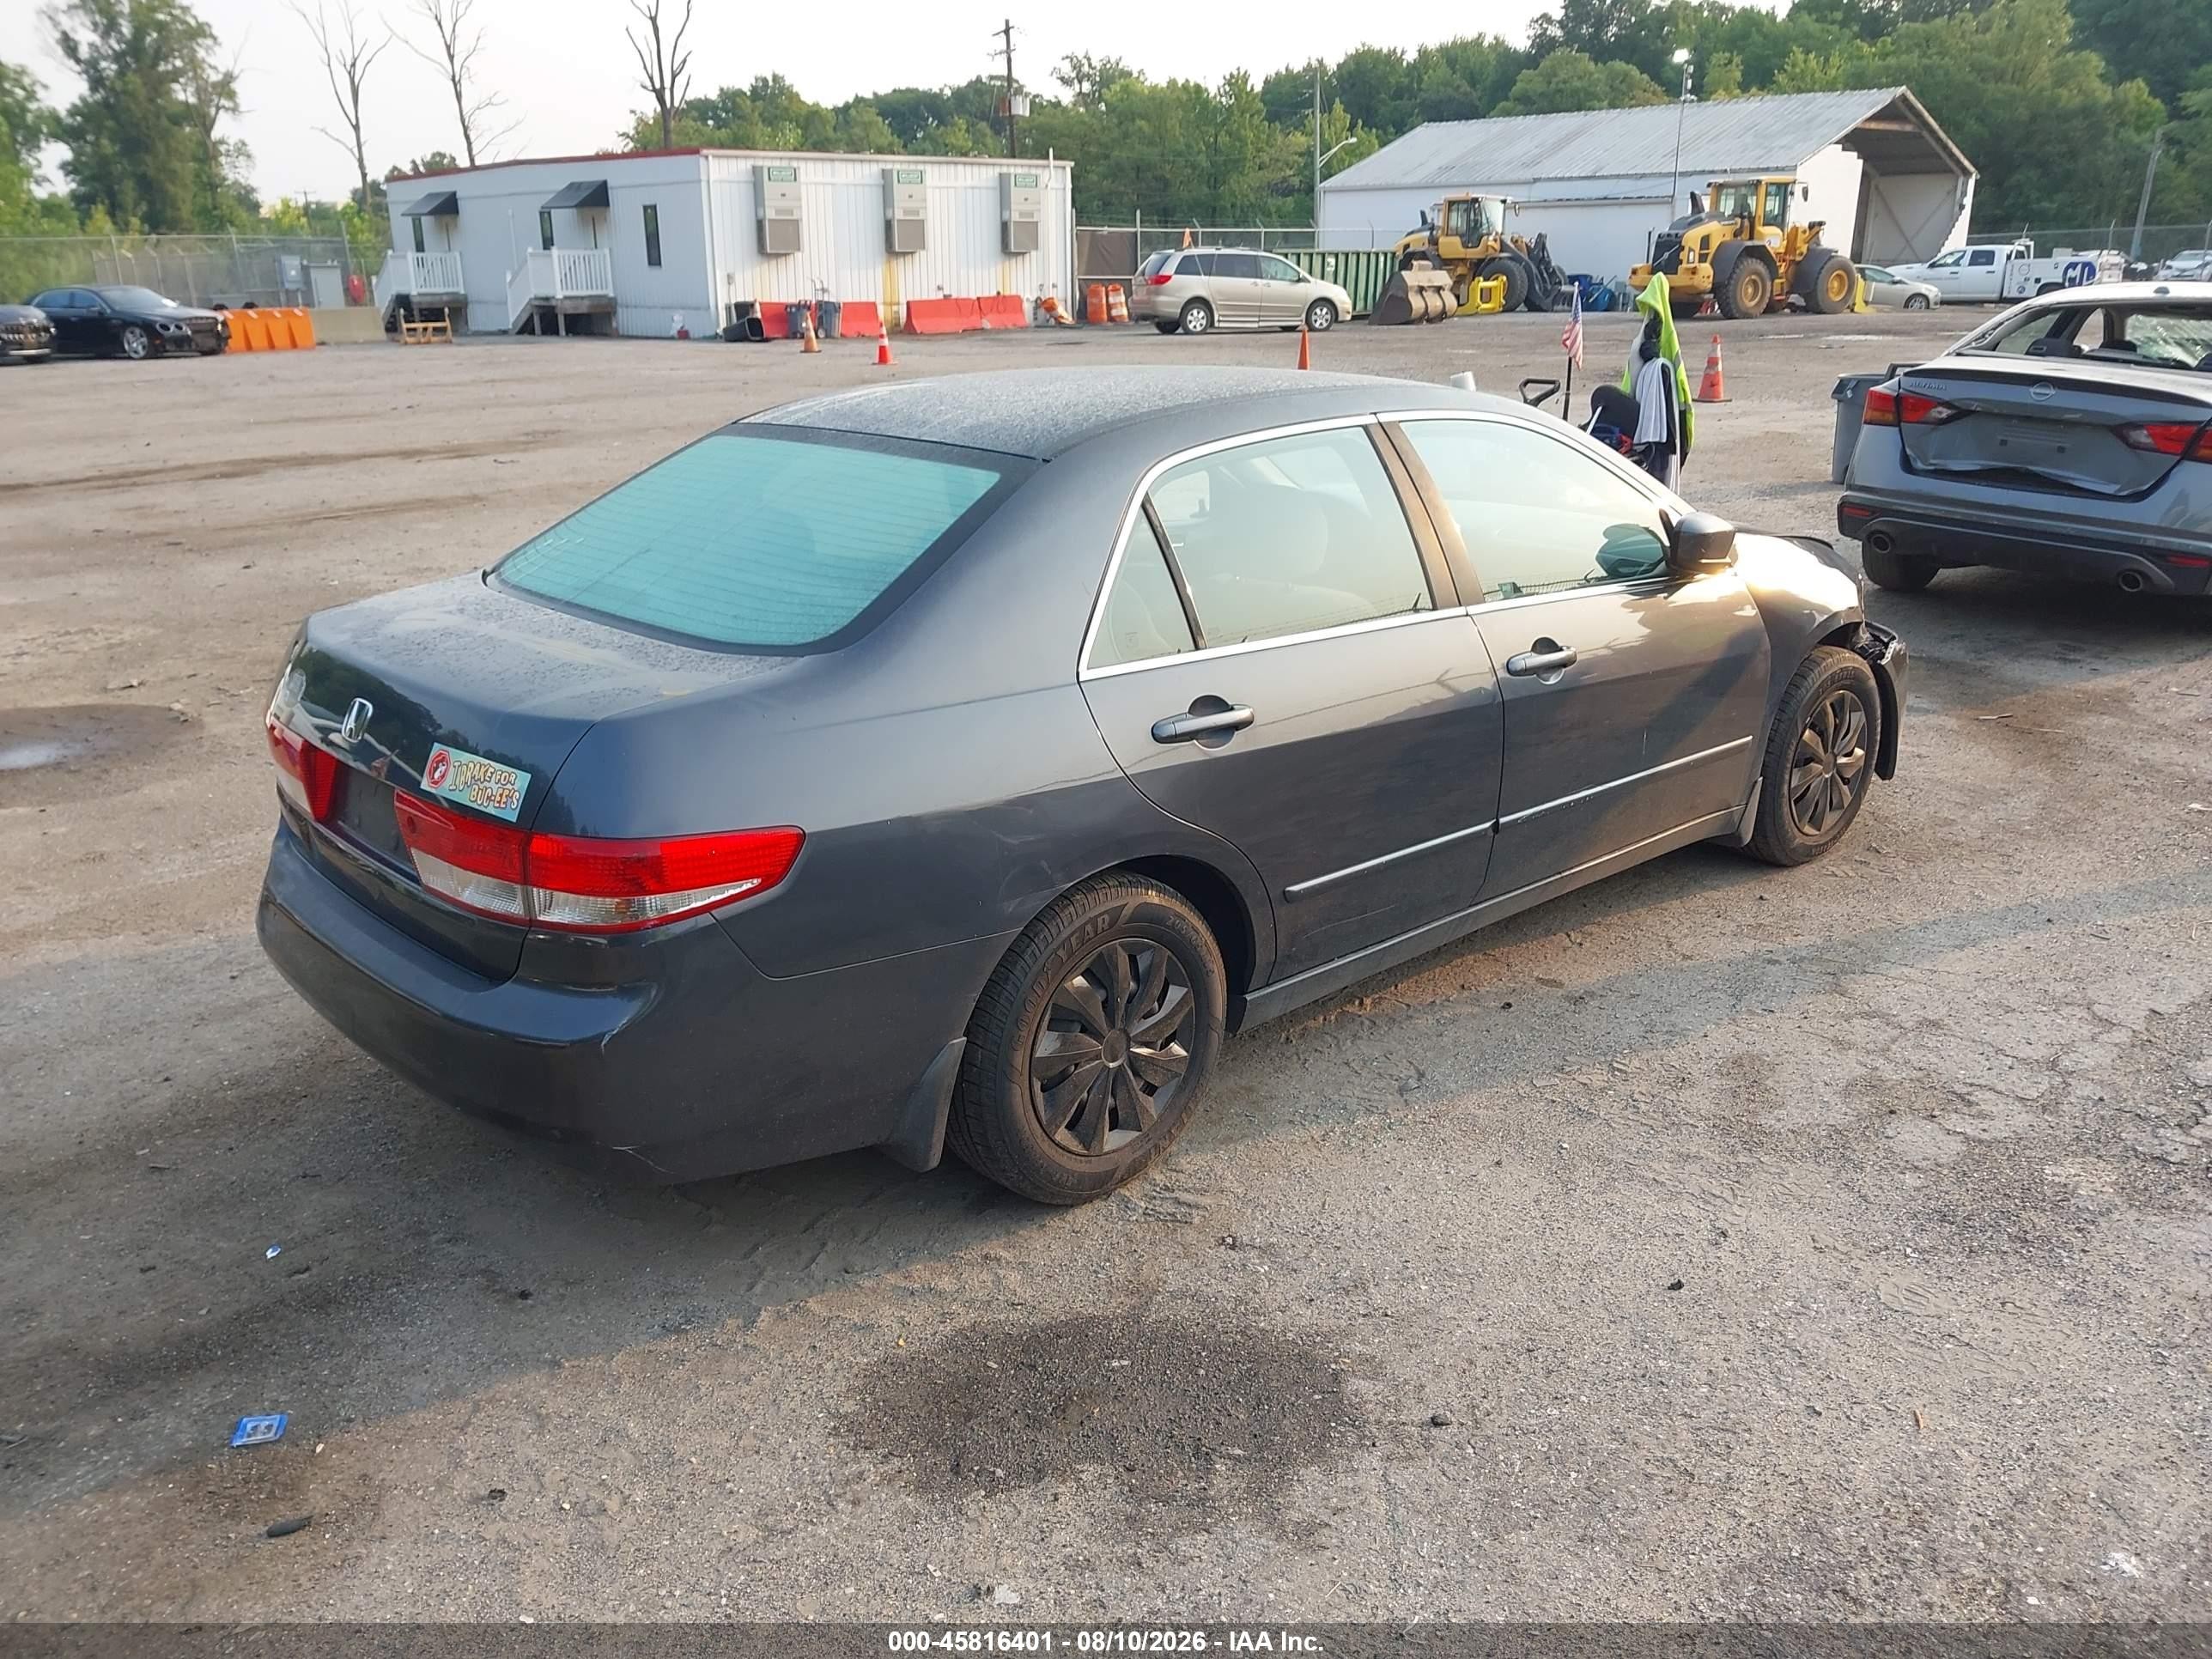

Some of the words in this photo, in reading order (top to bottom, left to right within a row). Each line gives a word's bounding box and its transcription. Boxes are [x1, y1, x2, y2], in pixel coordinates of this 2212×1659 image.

[449, 761, 461, 791] I
[459, 761, 496, 791] BRAKE
[495, 769, 517, 786] FOR
[469, 783, 521, 810] BUC-EE'S
